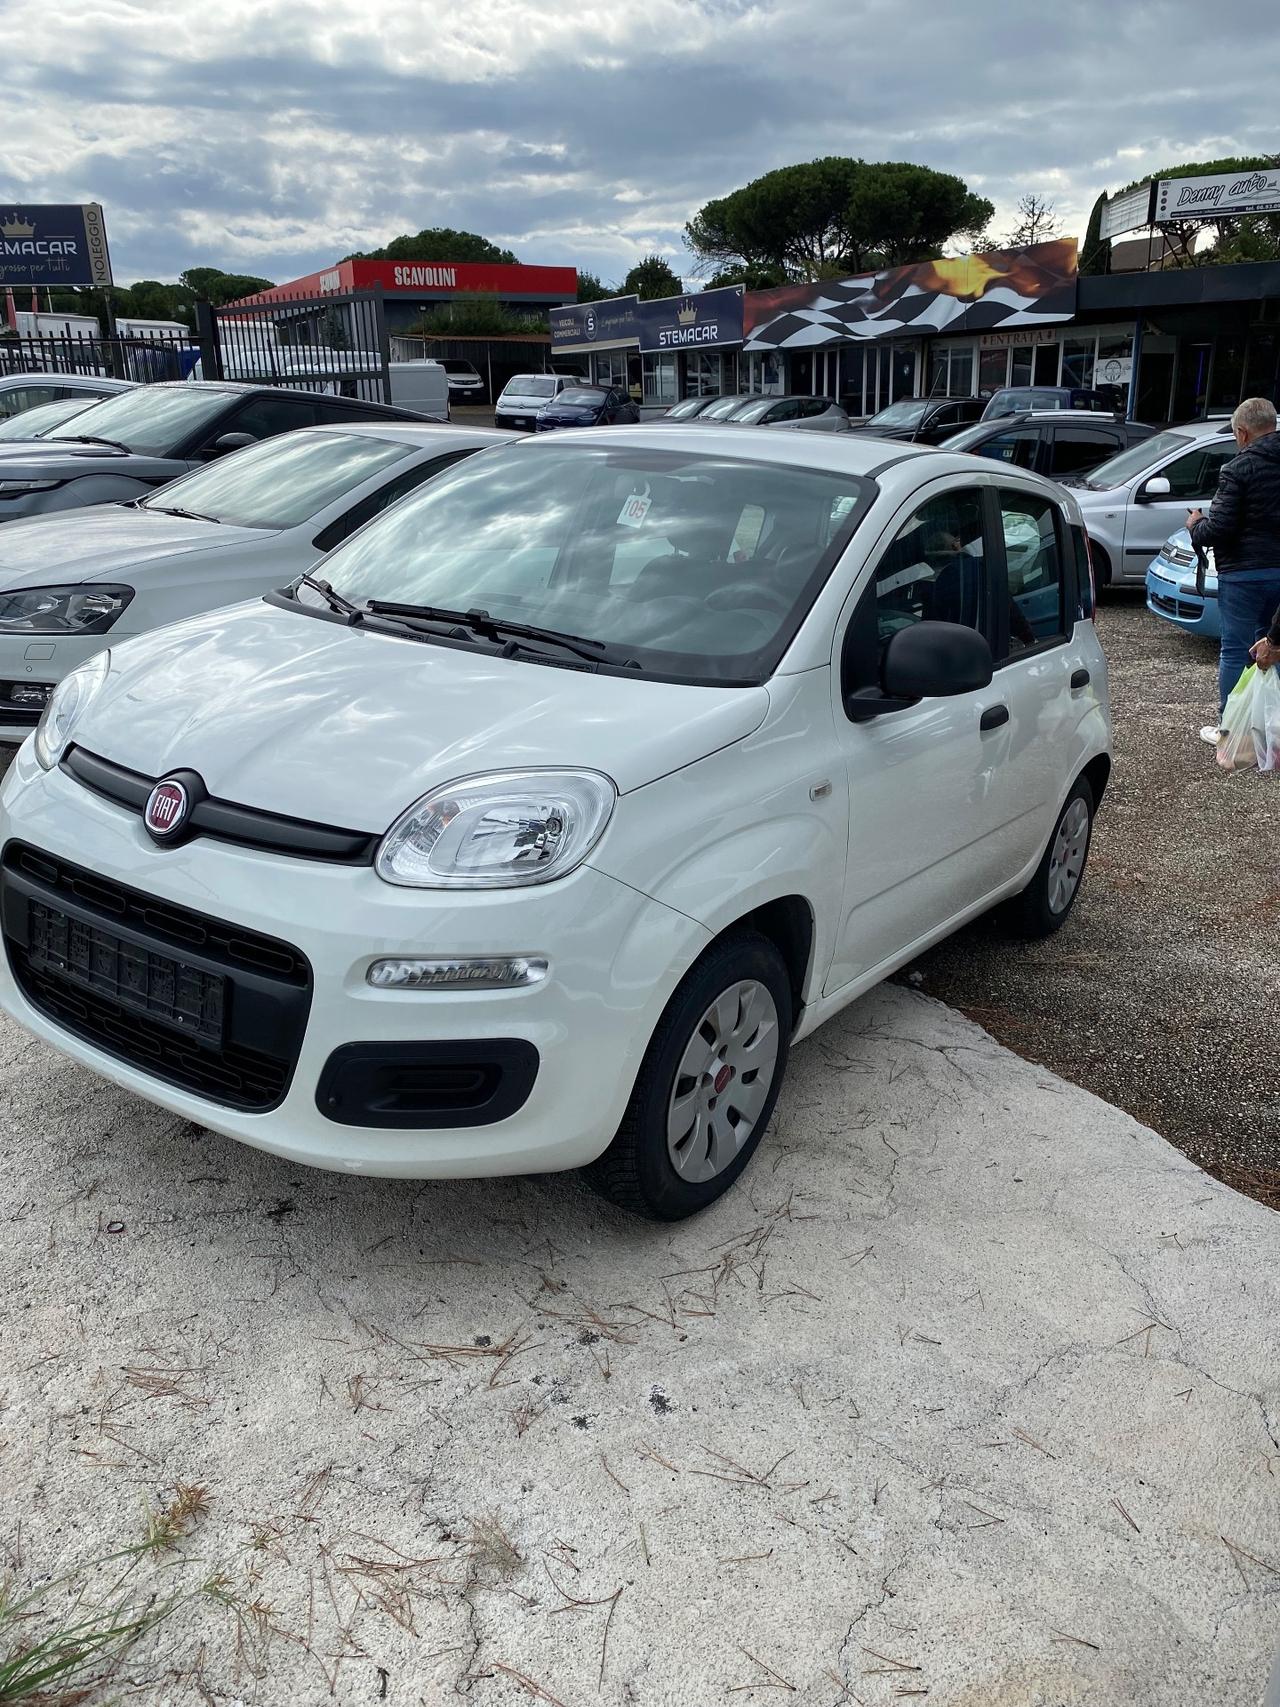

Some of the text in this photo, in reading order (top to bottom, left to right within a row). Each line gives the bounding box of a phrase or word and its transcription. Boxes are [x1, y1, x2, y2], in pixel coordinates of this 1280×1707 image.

[1177, 185, 1225, 206] Denny
[1229, 172, 1267, 196] auto
[87, 211, 106, 281] NOLEGGIO
[30, 264, 45, 279] per
[394, 266, 456, 287] SCAVOLINI
[659, 325, 718, 345] STEMACAR
[990, 330, 1043, 346] ENTRATA
[624, 500, 648, 519] 105
[152, 794, 179, 821] FIAT
